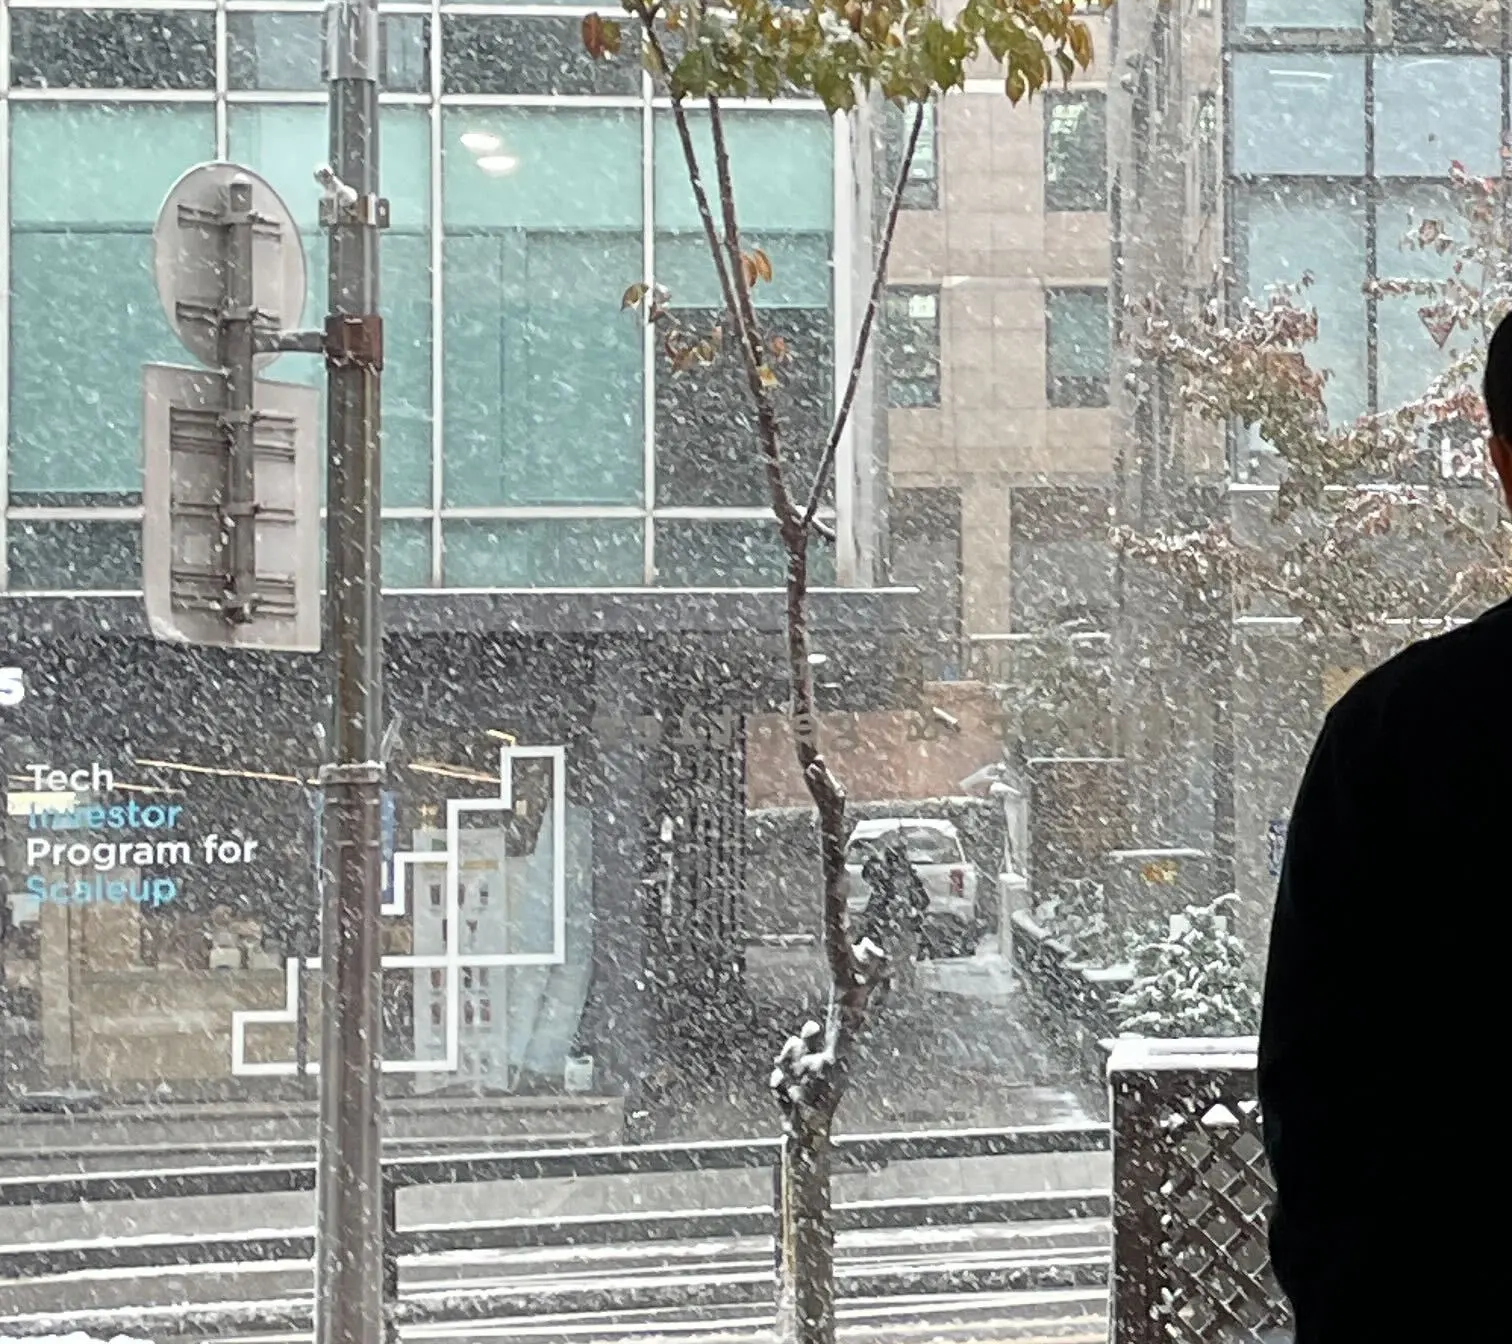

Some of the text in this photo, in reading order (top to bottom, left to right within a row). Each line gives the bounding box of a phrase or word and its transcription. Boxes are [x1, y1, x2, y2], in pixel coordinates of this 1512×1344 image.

[25, 761, 114, 792] Tech
[26, 833, 259, 870] Program for
[26, 873, 177, 907] Scaleup
